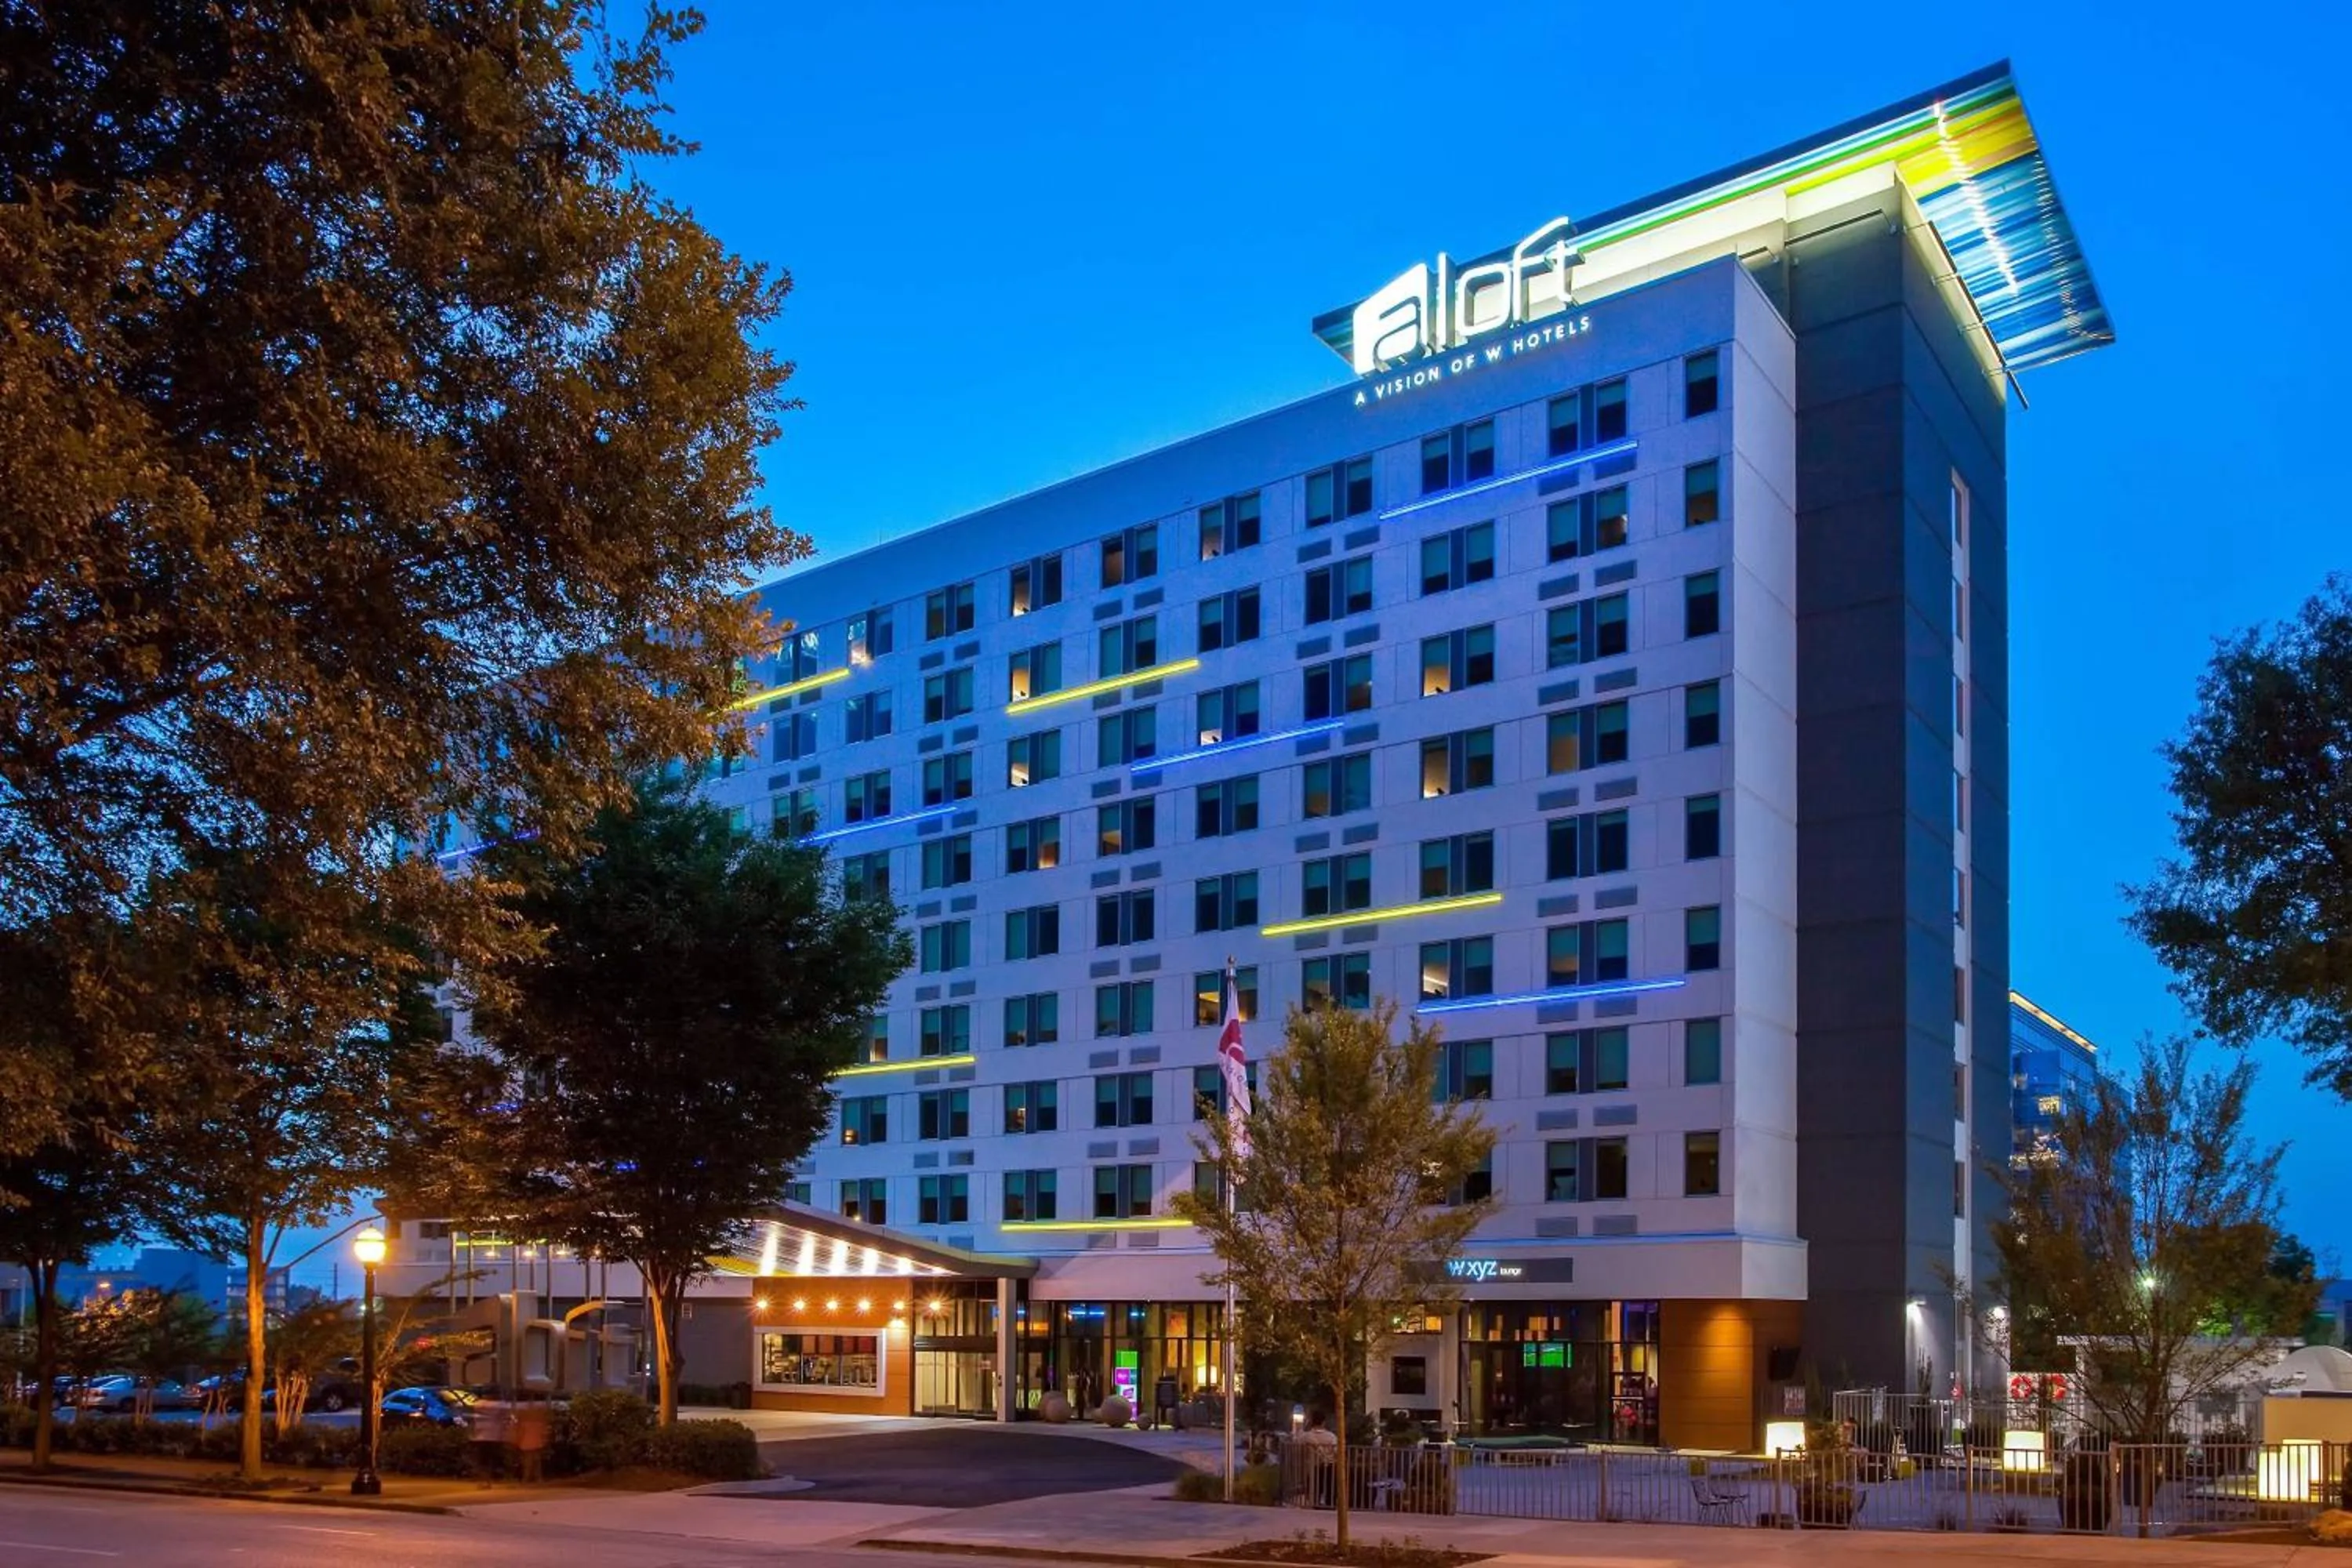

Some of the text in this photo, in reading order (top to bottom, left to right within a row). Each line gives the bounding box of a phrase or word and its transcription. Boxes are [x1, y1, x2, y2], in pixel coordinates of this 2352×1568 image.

[1353, 216, 1573, 375] aloft
[1355, 316, 1591, 406] A VISION OF W HOTELS
